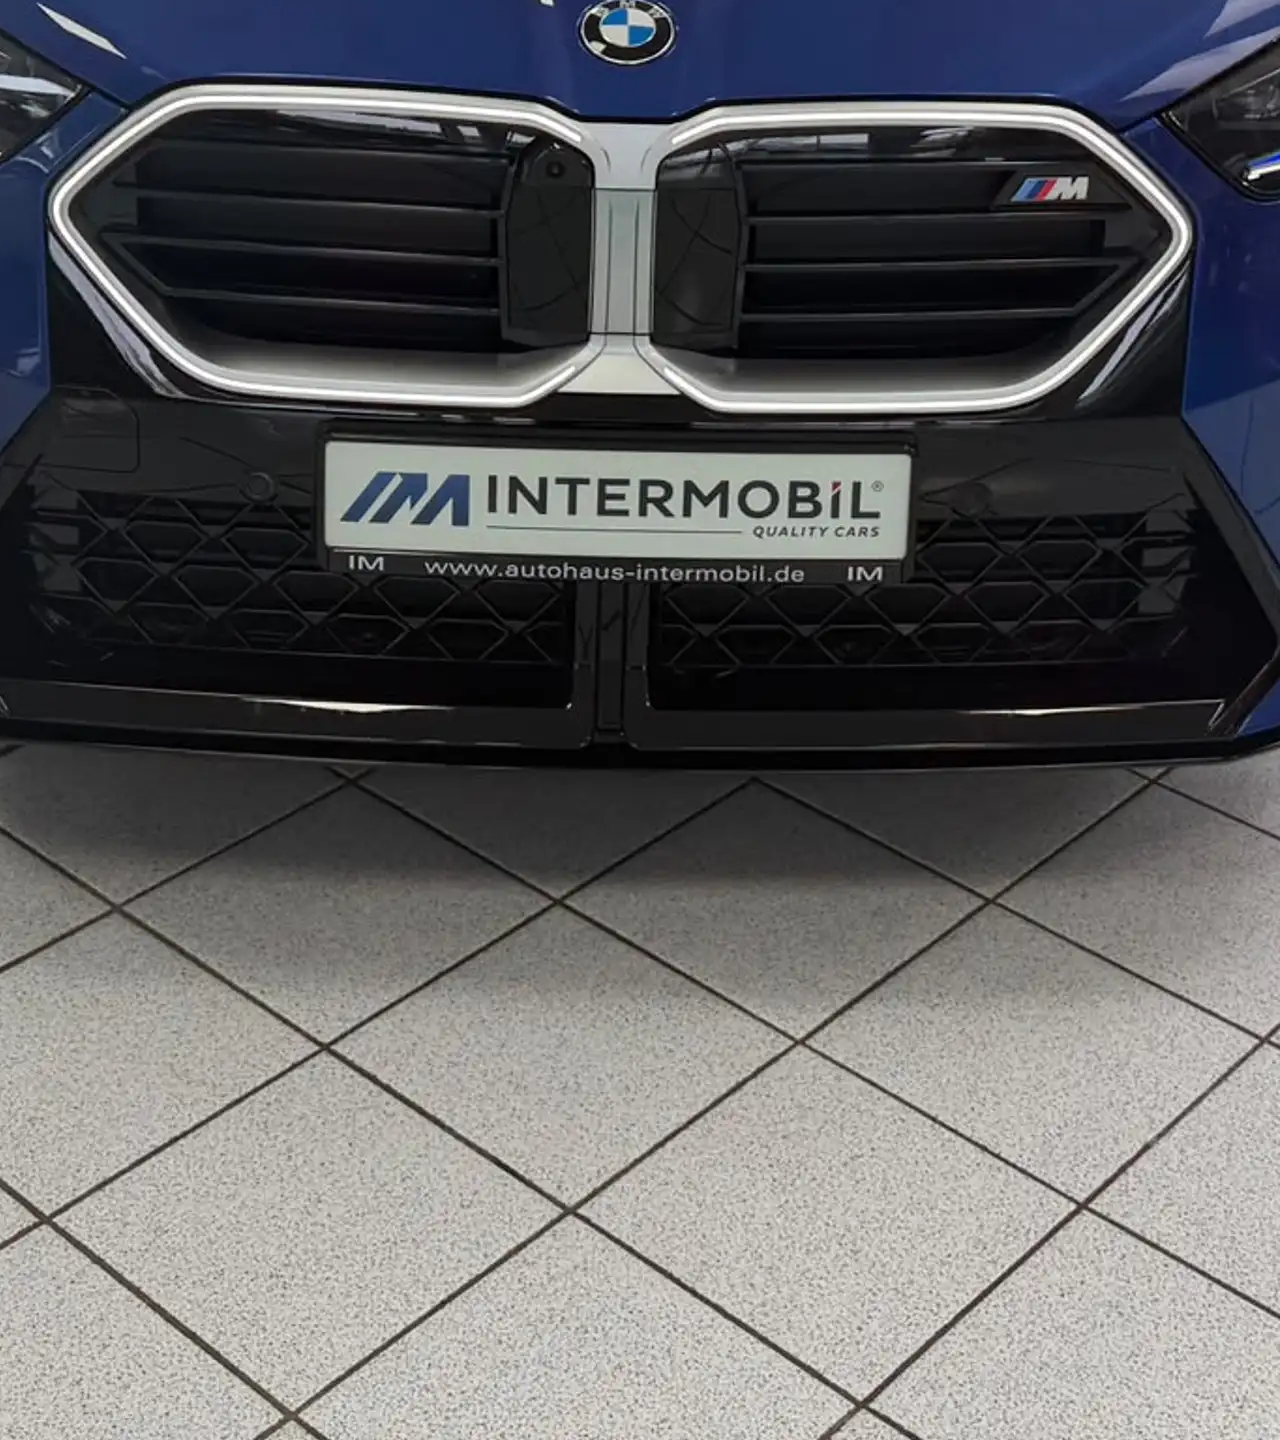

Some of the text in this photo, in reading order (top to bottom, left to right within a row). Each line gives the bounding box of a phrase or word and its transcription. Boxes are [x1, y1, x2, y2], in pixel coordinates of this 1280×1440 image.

[752, 525, 881, 539] QUALITY CARS
[348, 555, 884, 583] IM www.autohaus-intermobil.de IM
